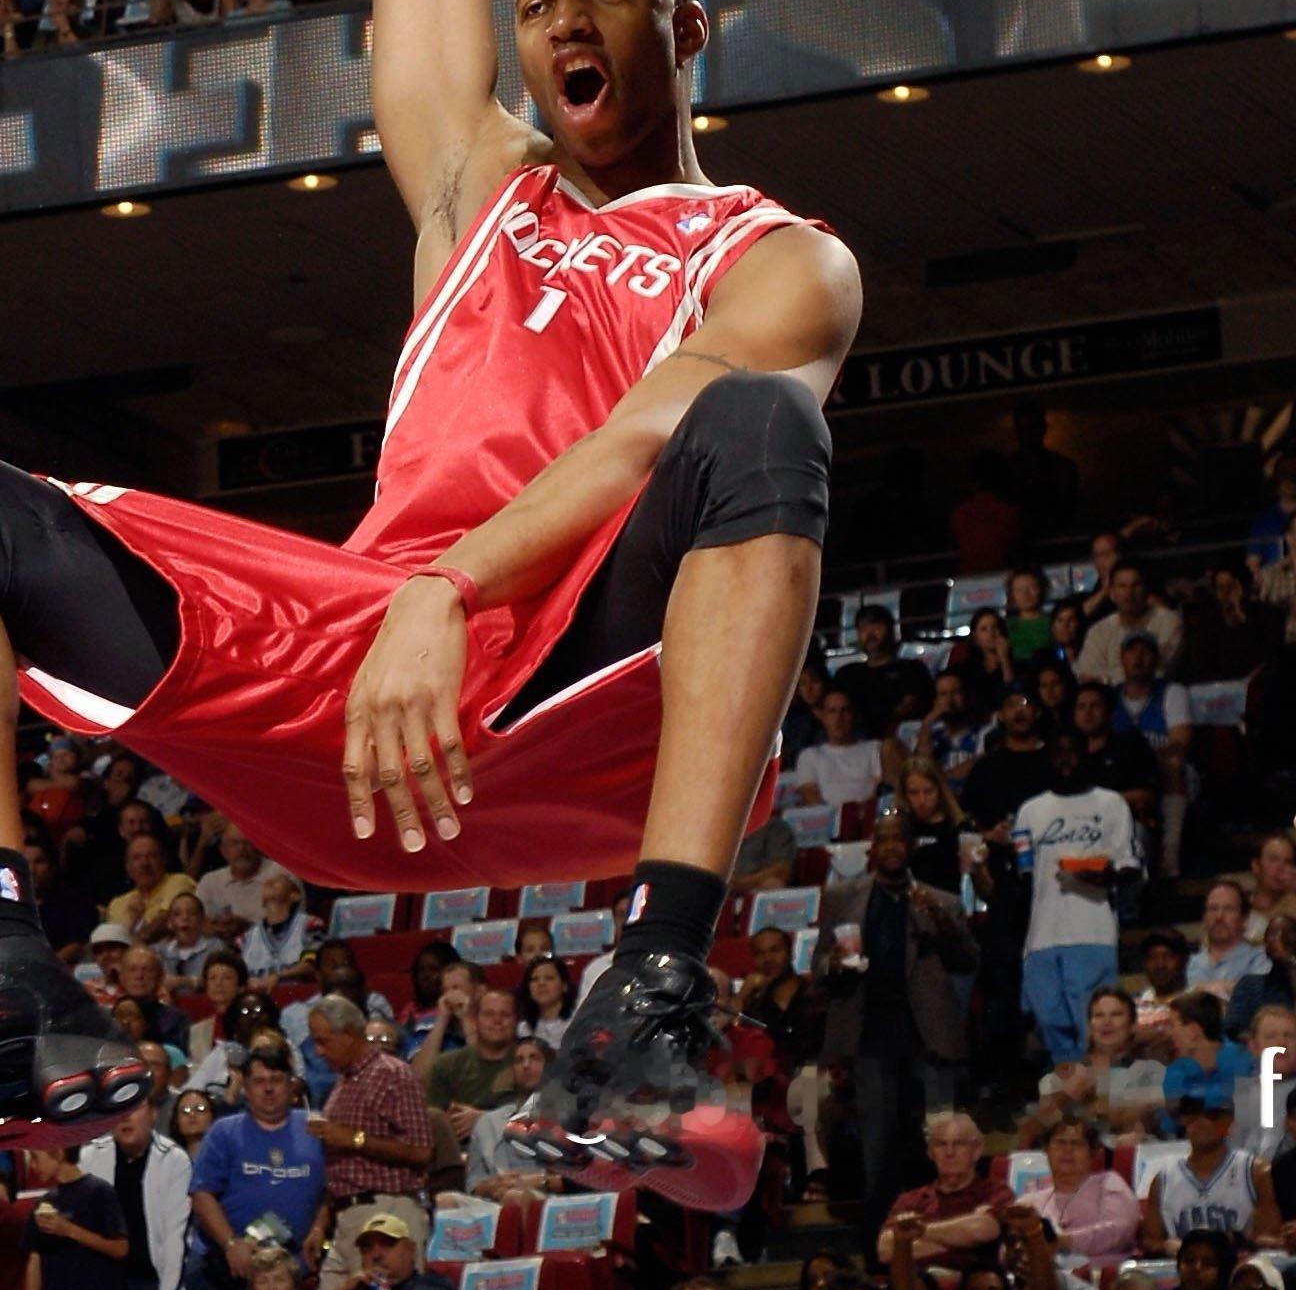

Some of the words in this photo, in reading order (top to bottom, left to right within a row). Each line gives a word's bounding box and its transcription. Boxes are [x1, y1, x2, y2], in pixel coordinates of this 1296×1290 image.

[501, 202, 682, 299] OCKETS
[522, 285, 568, 334] 1
[864, 334, 1090, 400] LOUNGE
